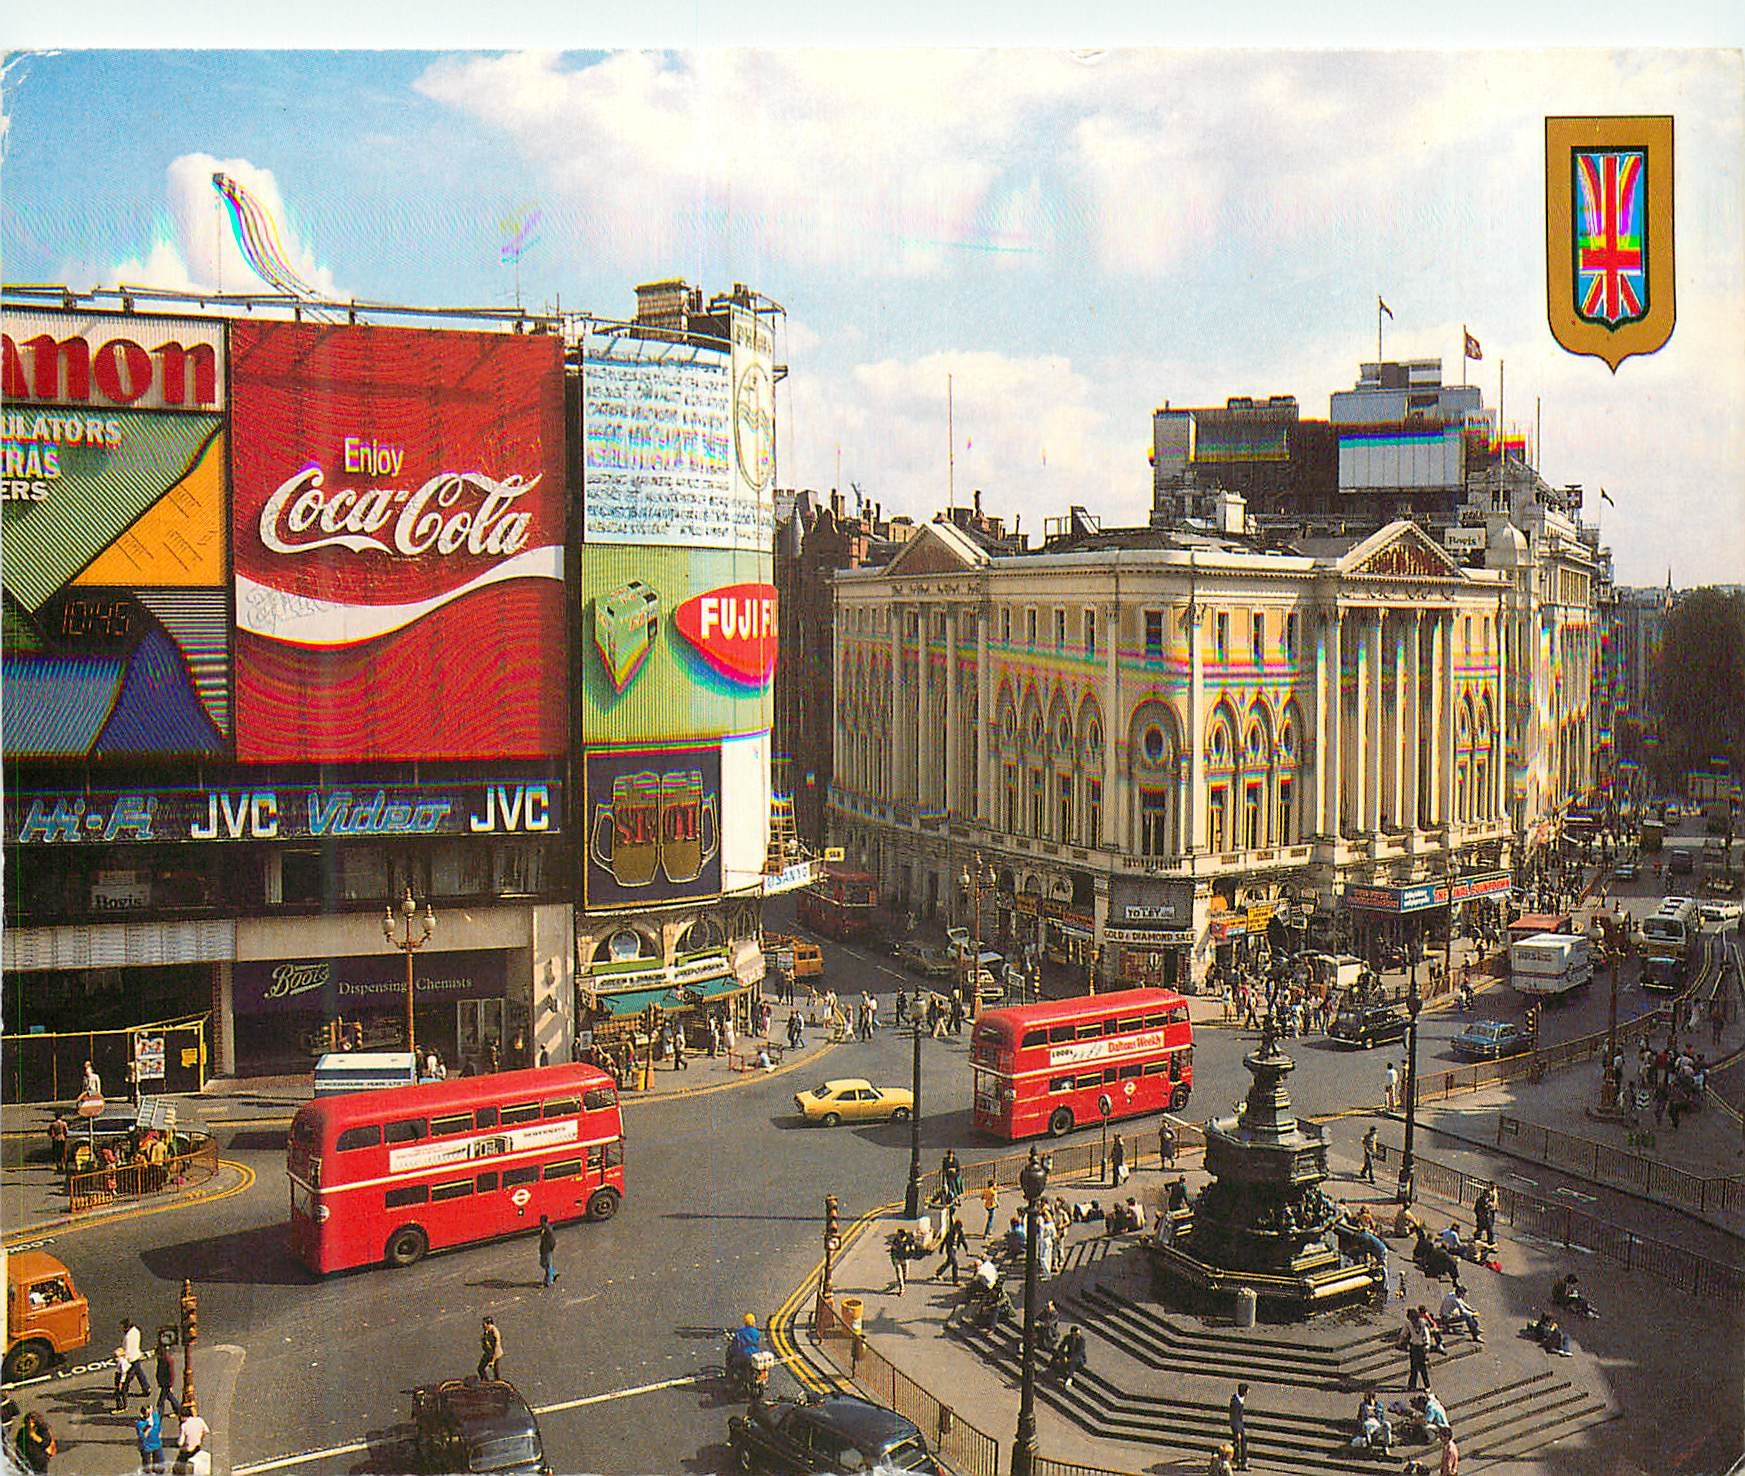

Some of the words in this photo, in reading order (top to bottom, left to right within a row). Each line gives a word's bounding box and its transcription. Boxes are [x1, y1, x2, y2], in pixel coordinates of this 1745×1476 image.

[345, 438, 404, 475] Enjoy
[260, 466, 543, 556] Coca-Cola
[191, 790, 280, 838] JVC
[308, 789, 452, 835] Video
[471, 785, 549, 832] JVC
[1104, 930, 1124, 939] GOLD
[1132, 931, 1173, 941] DIAMOND
[1175, 932, 1195, 941] SALE
[339, 979, 408, 995] Dispensing
[416, 977, 473, 990] Chemists
[58, 1358, 116, 1378] LOOK
